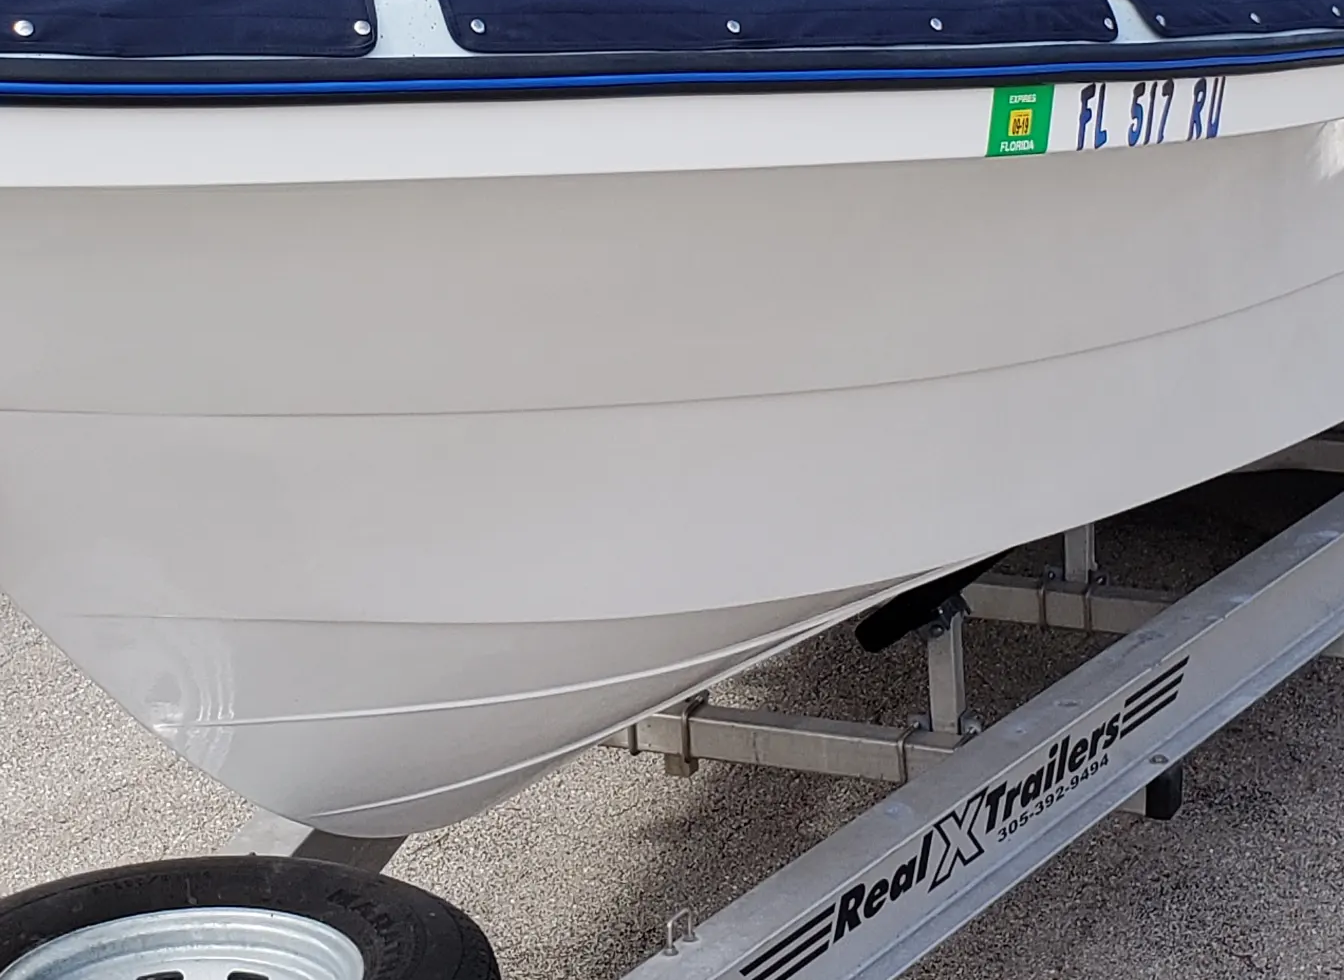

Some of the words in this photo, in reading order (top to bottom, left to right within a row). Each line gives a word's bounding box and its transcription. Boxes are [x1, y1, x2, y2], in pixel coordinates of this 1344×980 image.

[1009, 94, 1037, 104] EXPIRES
[1076, 82, 1108, 151] FL
[1127, 77, 1175, 147] 517
[1000, 139, 1035, 152] FLORIDA
[833, 829, 934, 944] Real
[985, 711, 1121, 835] Trailers
[997, 752, 1109, 843] 305-392-9494
